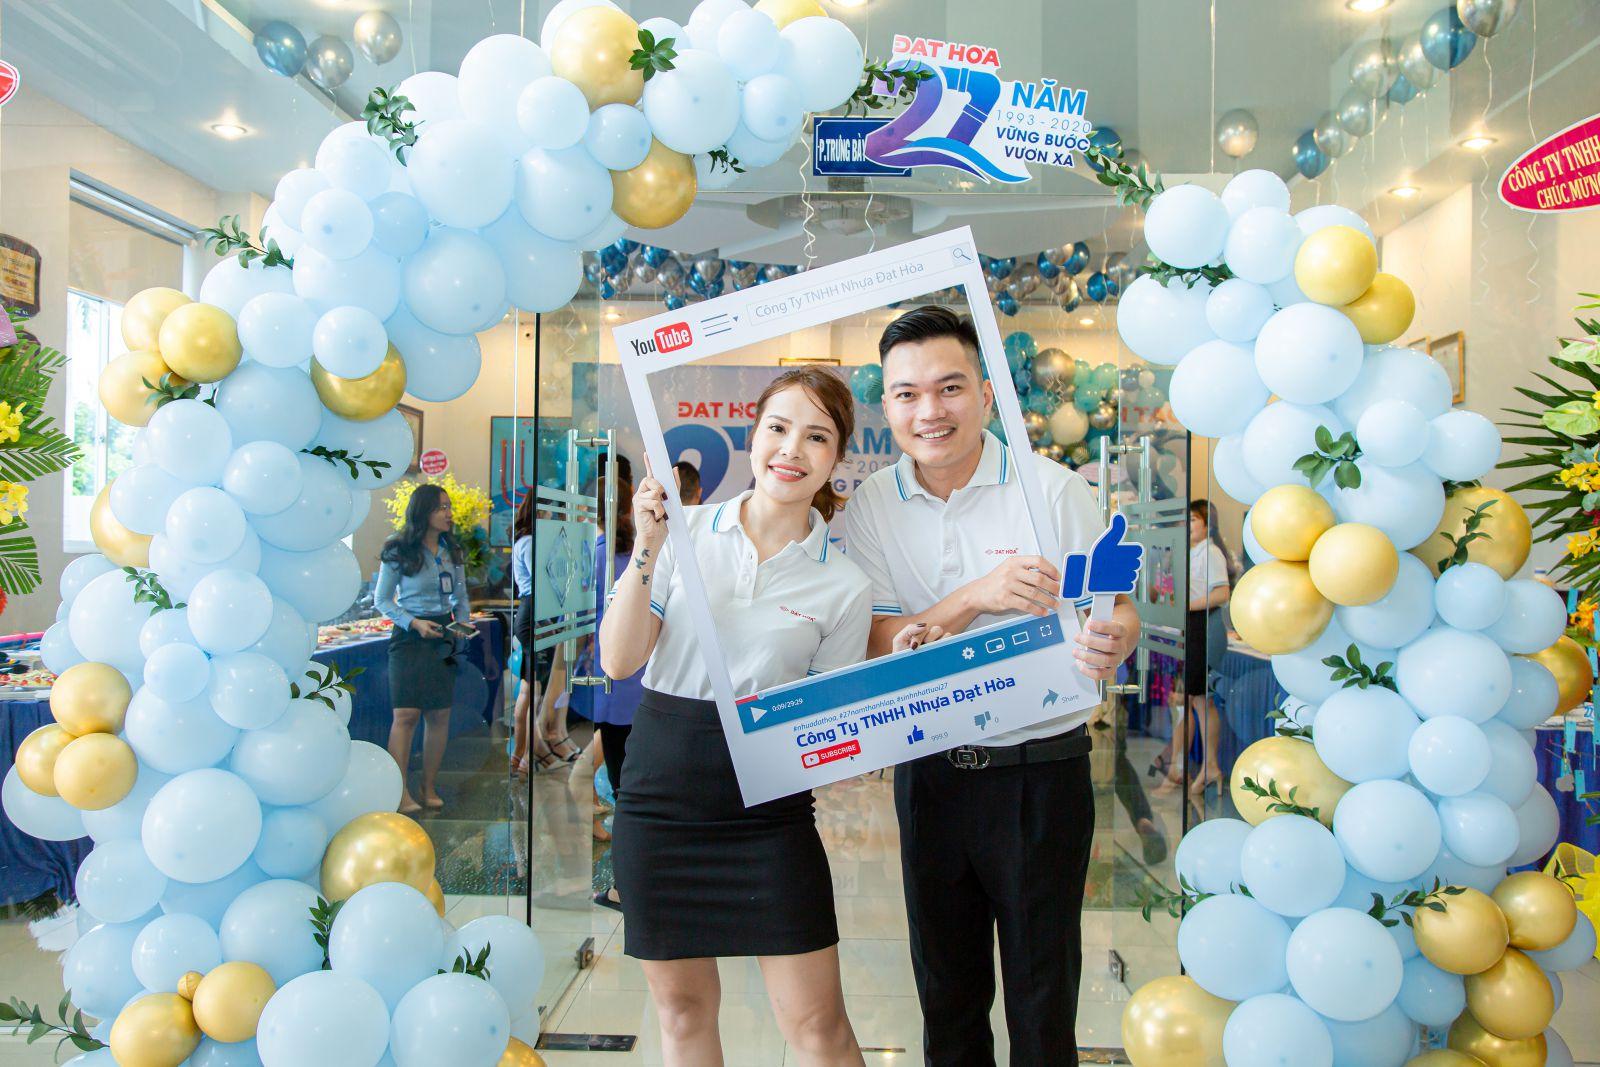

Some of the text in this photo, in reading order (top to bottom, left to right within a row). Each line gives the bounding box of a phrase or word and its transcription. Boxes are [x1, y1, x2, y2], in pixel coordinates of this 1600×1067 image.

[1012, 79, 1087, 116] NĂM
[996, 125, 1089, 151] VỮNG BƯỚC
[1005, 145, 1074, 167] VƯƠN XA
[1508, 134, 1600, 192] CÔNG TY TNHH
[1536, 179, 1571, 208] CHÚC
[755, 260, 924, 318] Công Ty TNHH Nhựa Đạt Hòa
[796, 675, 1017, 748] Công Ty TNHH Nhựa Đạt Hòa
[1061, 694, 1079, 704] Share
[820, 744, 857, 761] SUBSCRIBE
